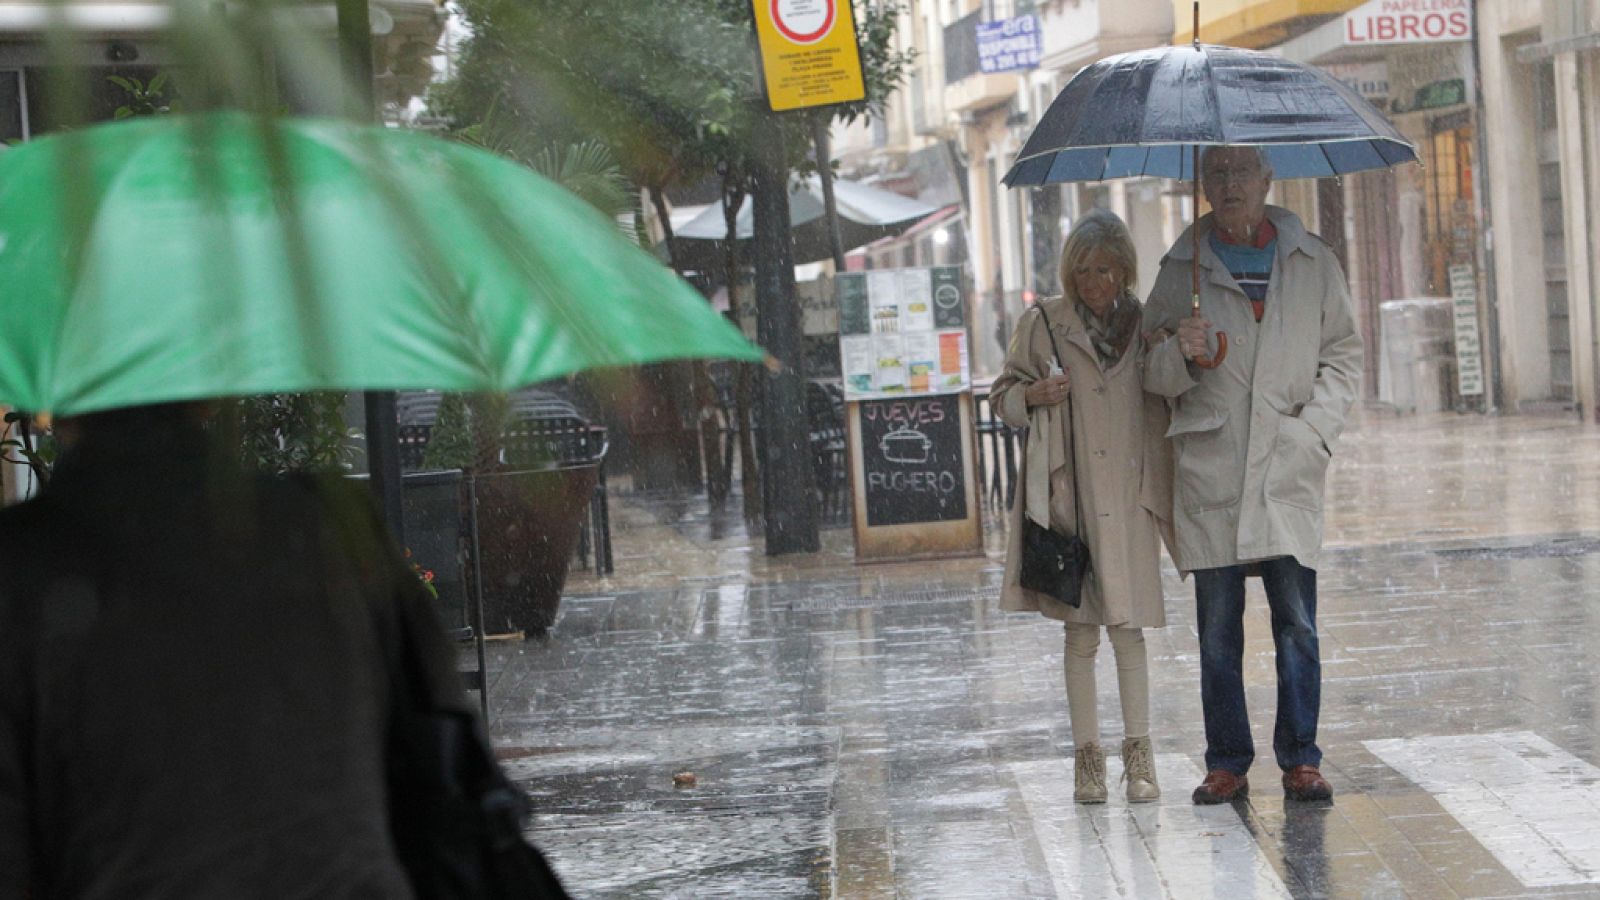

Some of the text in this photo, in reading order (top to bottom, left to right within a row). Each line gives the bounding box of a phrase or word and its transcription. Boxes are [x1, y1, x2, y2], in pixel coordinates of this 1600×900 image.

[1347, 12, 1468, 41] LIBROS
[864, 401, 945, 424] JUEVES
[868, 470, 956, 493] PUCHERO
